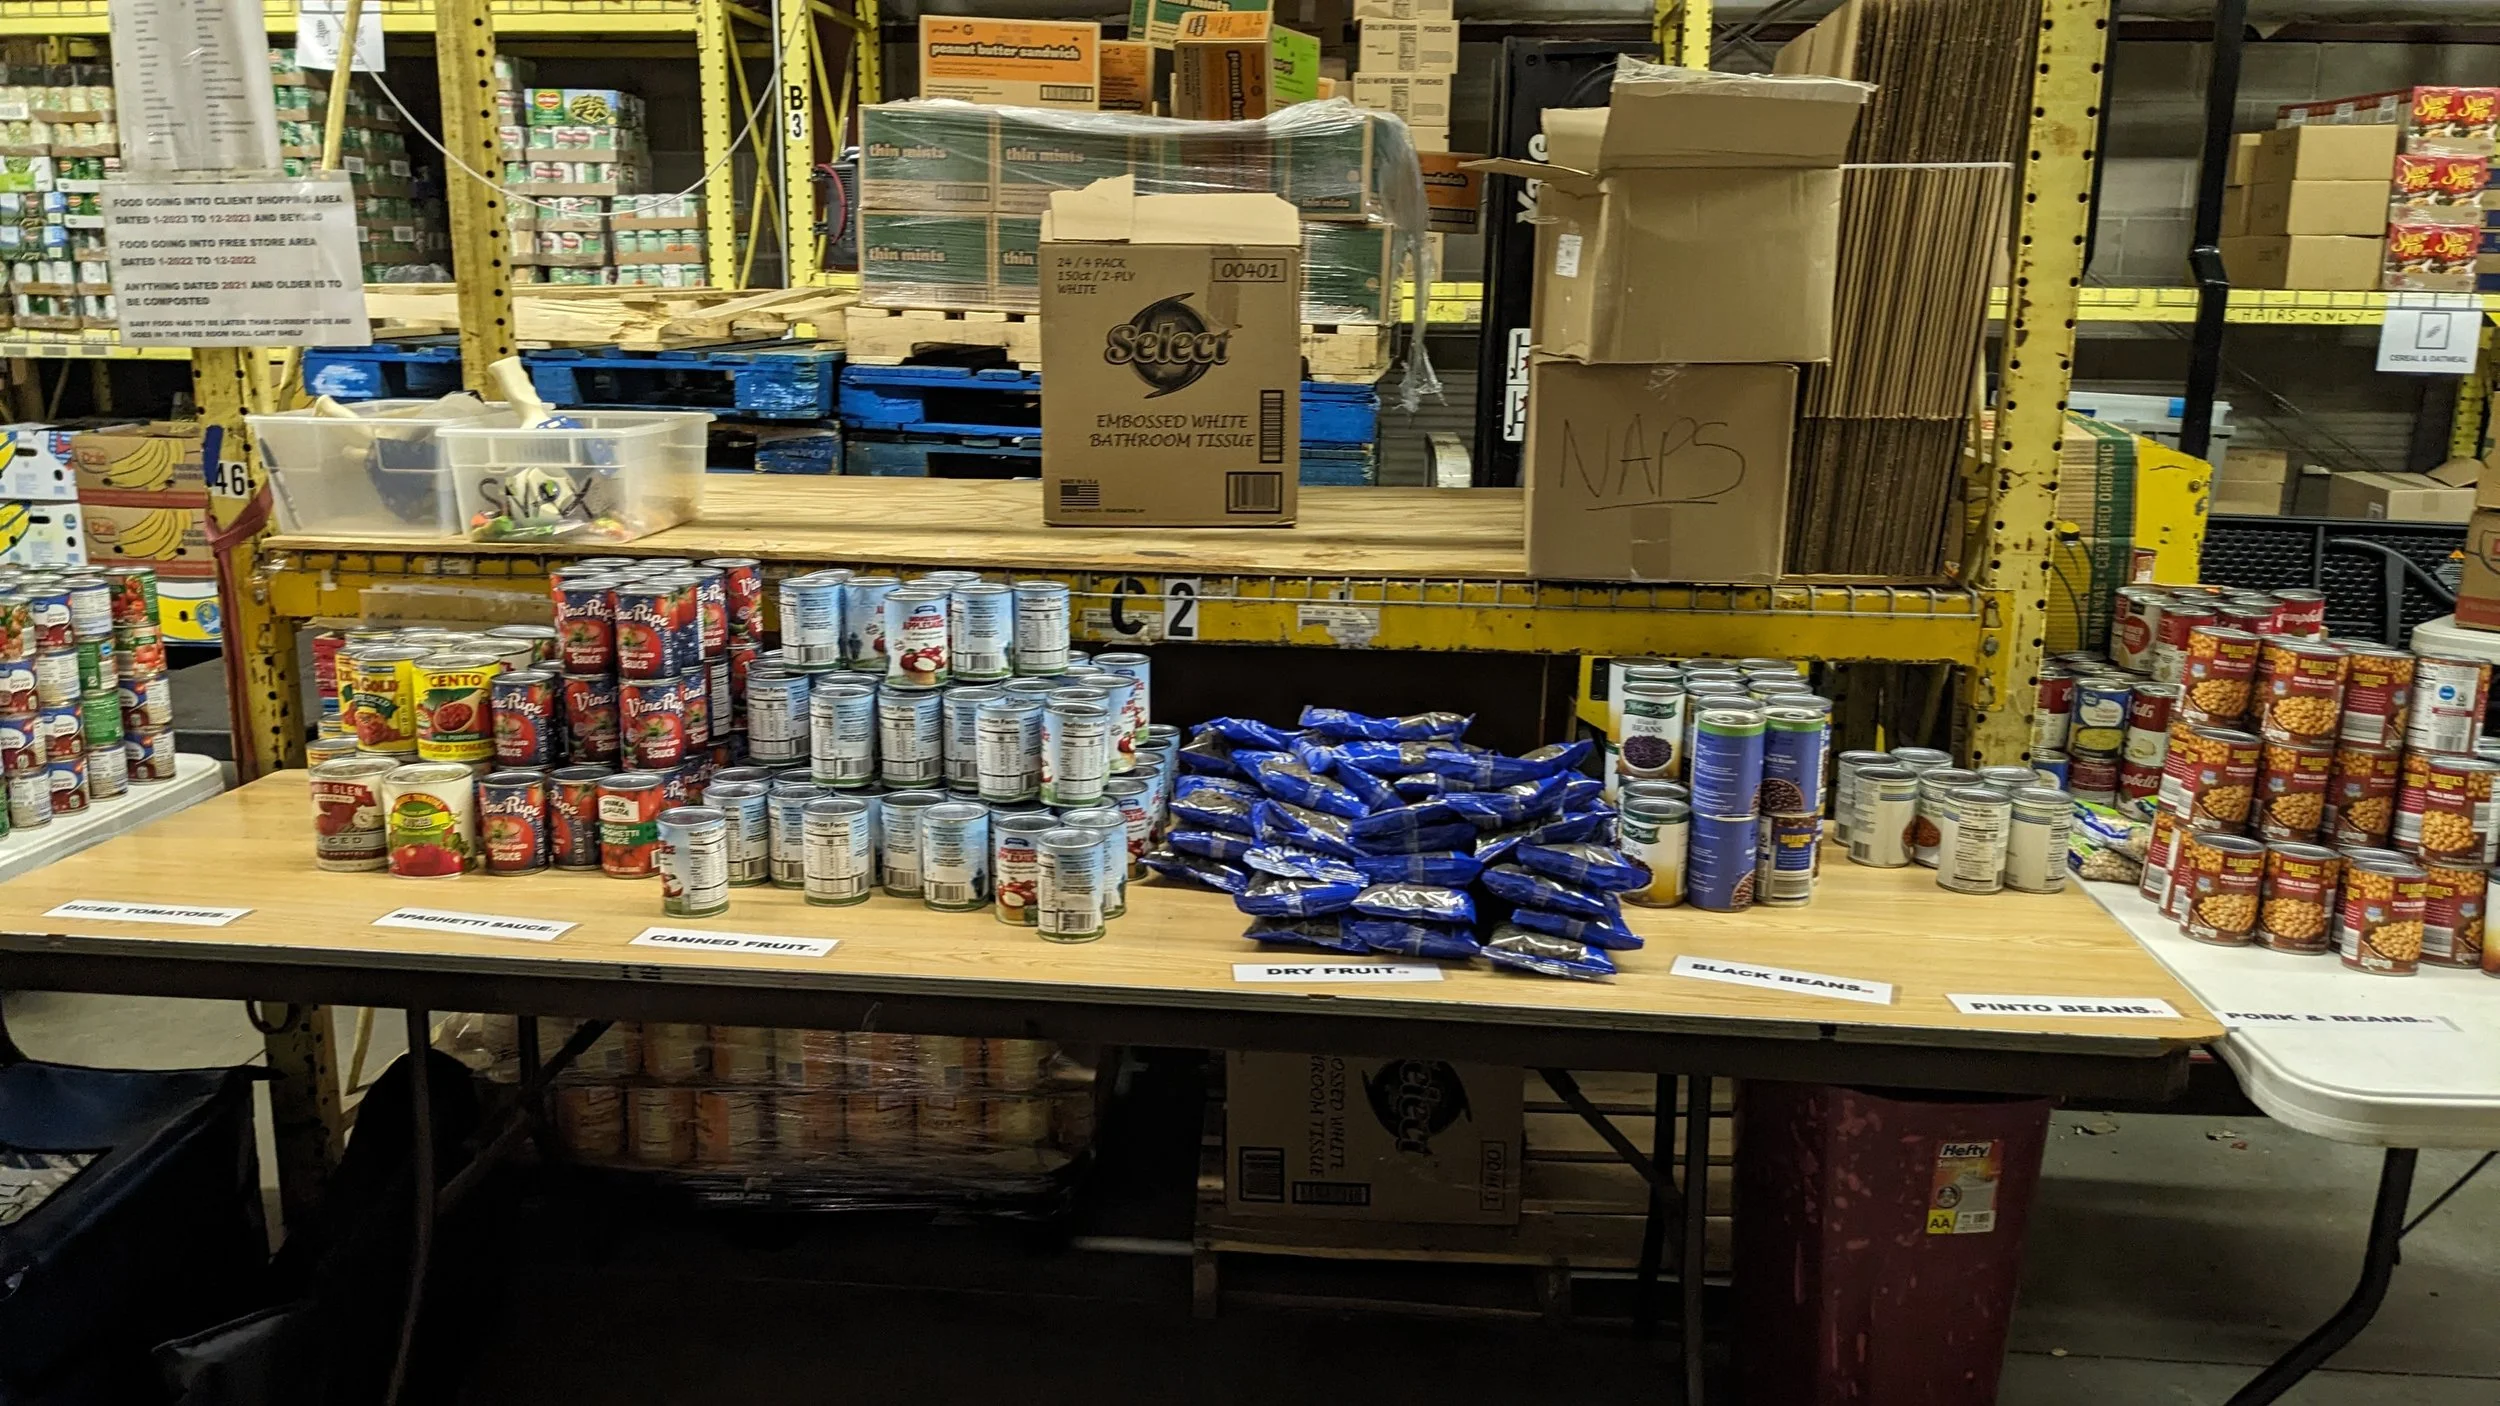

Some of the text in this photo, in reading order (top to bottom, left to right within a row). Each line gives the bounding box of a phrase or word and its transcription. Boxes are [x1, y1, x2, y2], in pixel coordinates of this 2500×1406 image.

[930, 41, 1081, 61] peanut butter sandwich
[790, 85, 803, 110] B
[793, 114, 801, 137] 3
[869, 143, 947, 159] thin mints
[1006, 147, 1086, 163] thin mints
[113, 195, 343, 207] FOOD GOING INTO CLIENT SHOPPING AREA
[116, 216, 151, 224] DATED
[153, 215, 188, 223] 1-2023
[191, 215, 206, 223] TO
[210, 214, 251, 223] 12-2023
[254, 213, 277, 222] AND
[119, 237, 317, 248] FOOD GOING INTO FREE STORE AREA
[121, 256, 256, 266] DATED 1-2022 TO 12-2022
[868, 247, 946, 263] thin mints
[1002, 251, 1034, 266] thin
[1057, 257, 1071, 269] 24
[1094, 257, 1127, 268] PACK
[1221, 262, 1278, 279] 00401
[1102, 271, 1136, 282] 2-PLY
[124, 282, 180, 291] ANYTHING
[183, 281, 219, 290] DATED
[250, 281, 274, 289] AND
[276, 281, 312, 289] OLDER
[314, 280, 325, 288] IS
[328, 280, 343, 288] TO
[1057, 284, 1097, 295] WHITE
[126, 297, 210, 306] BE COMPOSTED
[1104, 322, 1234, 366] Select
[1096, 414, 1249, 429] EMBOSSED WHITE
[1089, 433, 1256, 448] BATHROOM TISSUE
[1560, 413, 1747, 500] NAPS
[2095, 443, 2115, 570] CERTIFIED ORGANIC
[1111, 577, 1148, 636] C
[1168, 582, 1195, 637] 2
[632, 602, 670, 628] Ripe
[571, 654, 602, 665] Sauce
[430, 674, 483, 688] CENTO
[507, 692, 544, 716] Ripe
[573, 691, 610, 712] Vine
[626, 697, 664, 718] Vine
[646, 747, 676, 759] Sauce
[506, 796, 541, 819] Ripe
[491, 849, 522, 862] Sauce
[64, 904, 223, 919] DICED TOMATOES
[392, 913, 550, 932] SPAGHETTI SAUCE
[650, 934, 812, 951] CANNED FRUIT
[1267, 967, 1396, 975] DRY FRUIT
[1691, 963, 1862, 992] BLACK BEANS
[1970, 1002, 2151, 1014] PINTO BEANS
[2225, 1012, 2300, 1021] PORK
[2305, 1014, 2326, 1022] &
[2329, 1014, 2420, 1023] BEANS
[1308, 1116, 1325, 1177] TISSUE
[1329, 1114, 1346, 1170] WHITE
[1943, 1143, 1989, 1158] Hefty
[1930, 1218, 1951, 1229] AA
